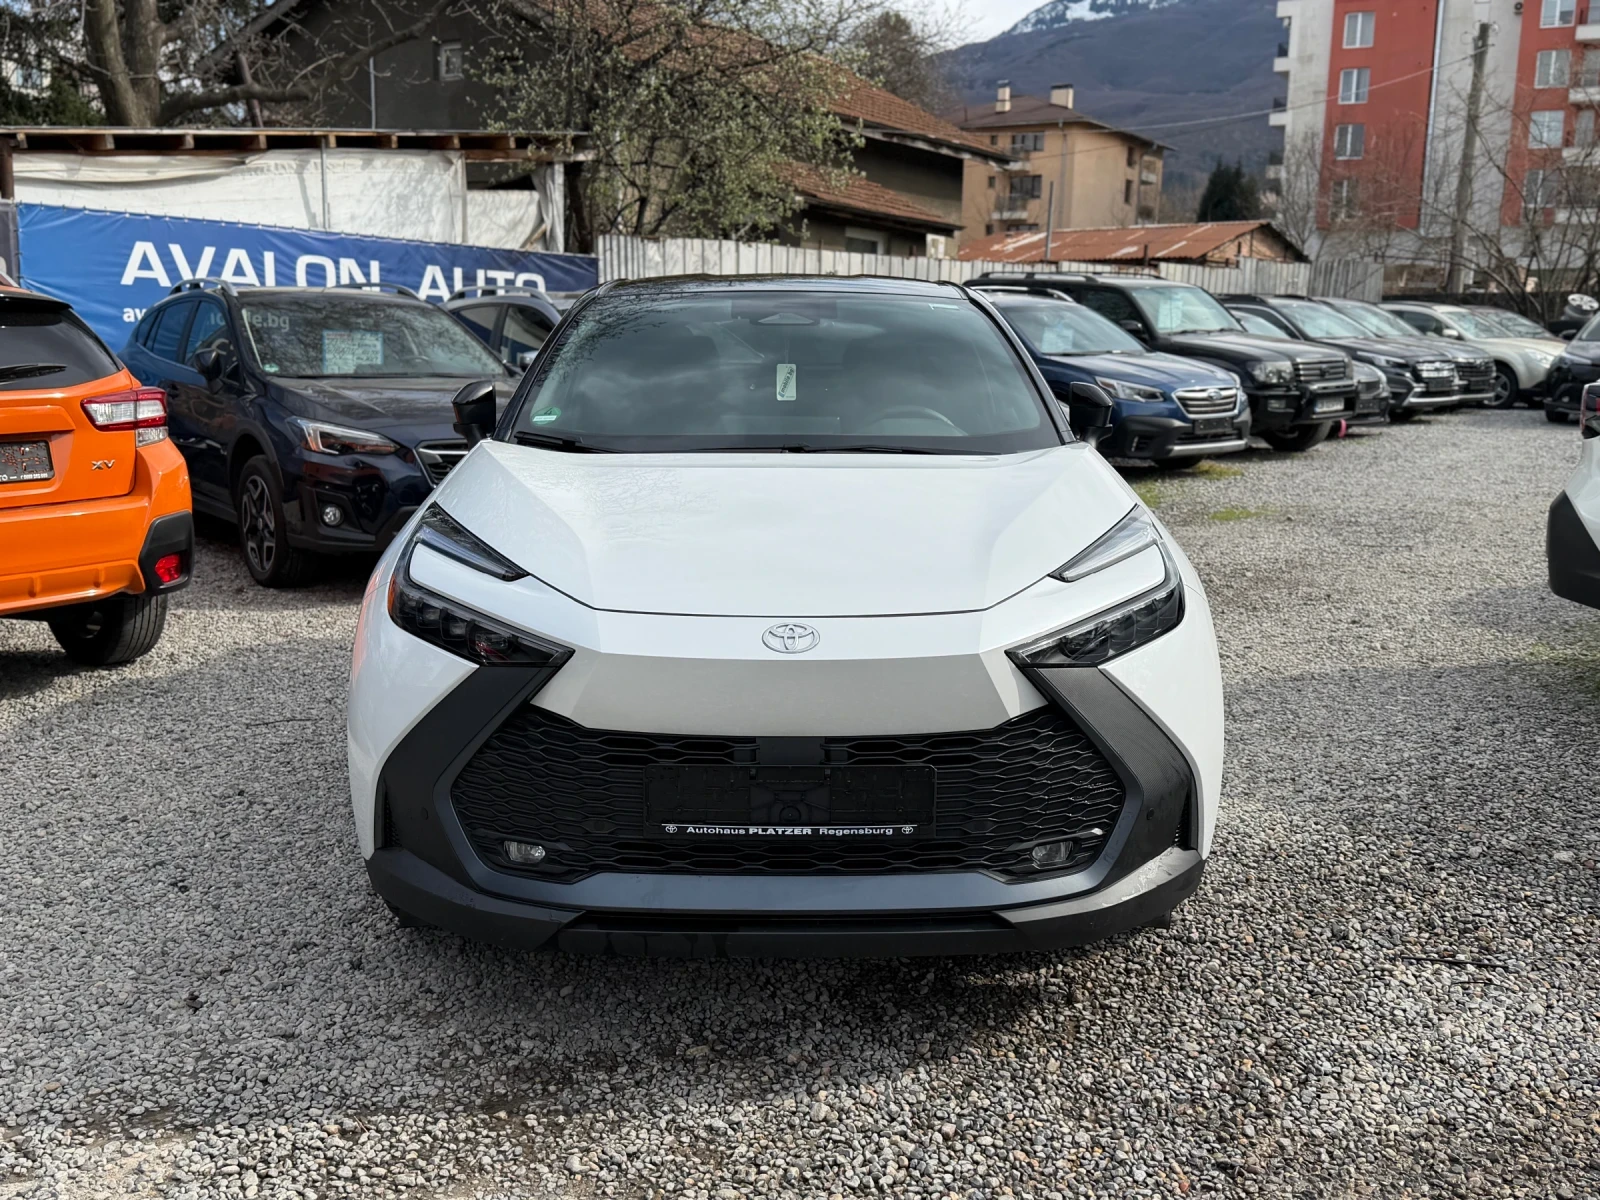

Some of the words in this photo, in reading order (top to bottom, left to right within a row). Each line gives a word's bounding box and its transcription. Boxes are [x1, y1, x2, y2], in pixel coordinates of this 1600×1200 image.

[120, 241, 381, 292] AVALON
[418, 264, 547, 302] AUTO
[91, 459, 116, 471] XV
[686, 826, 746, 835] Autohaus
[748, 827, 812, 835] PLATZER
[819, 827, 893, 837] Regensburg
